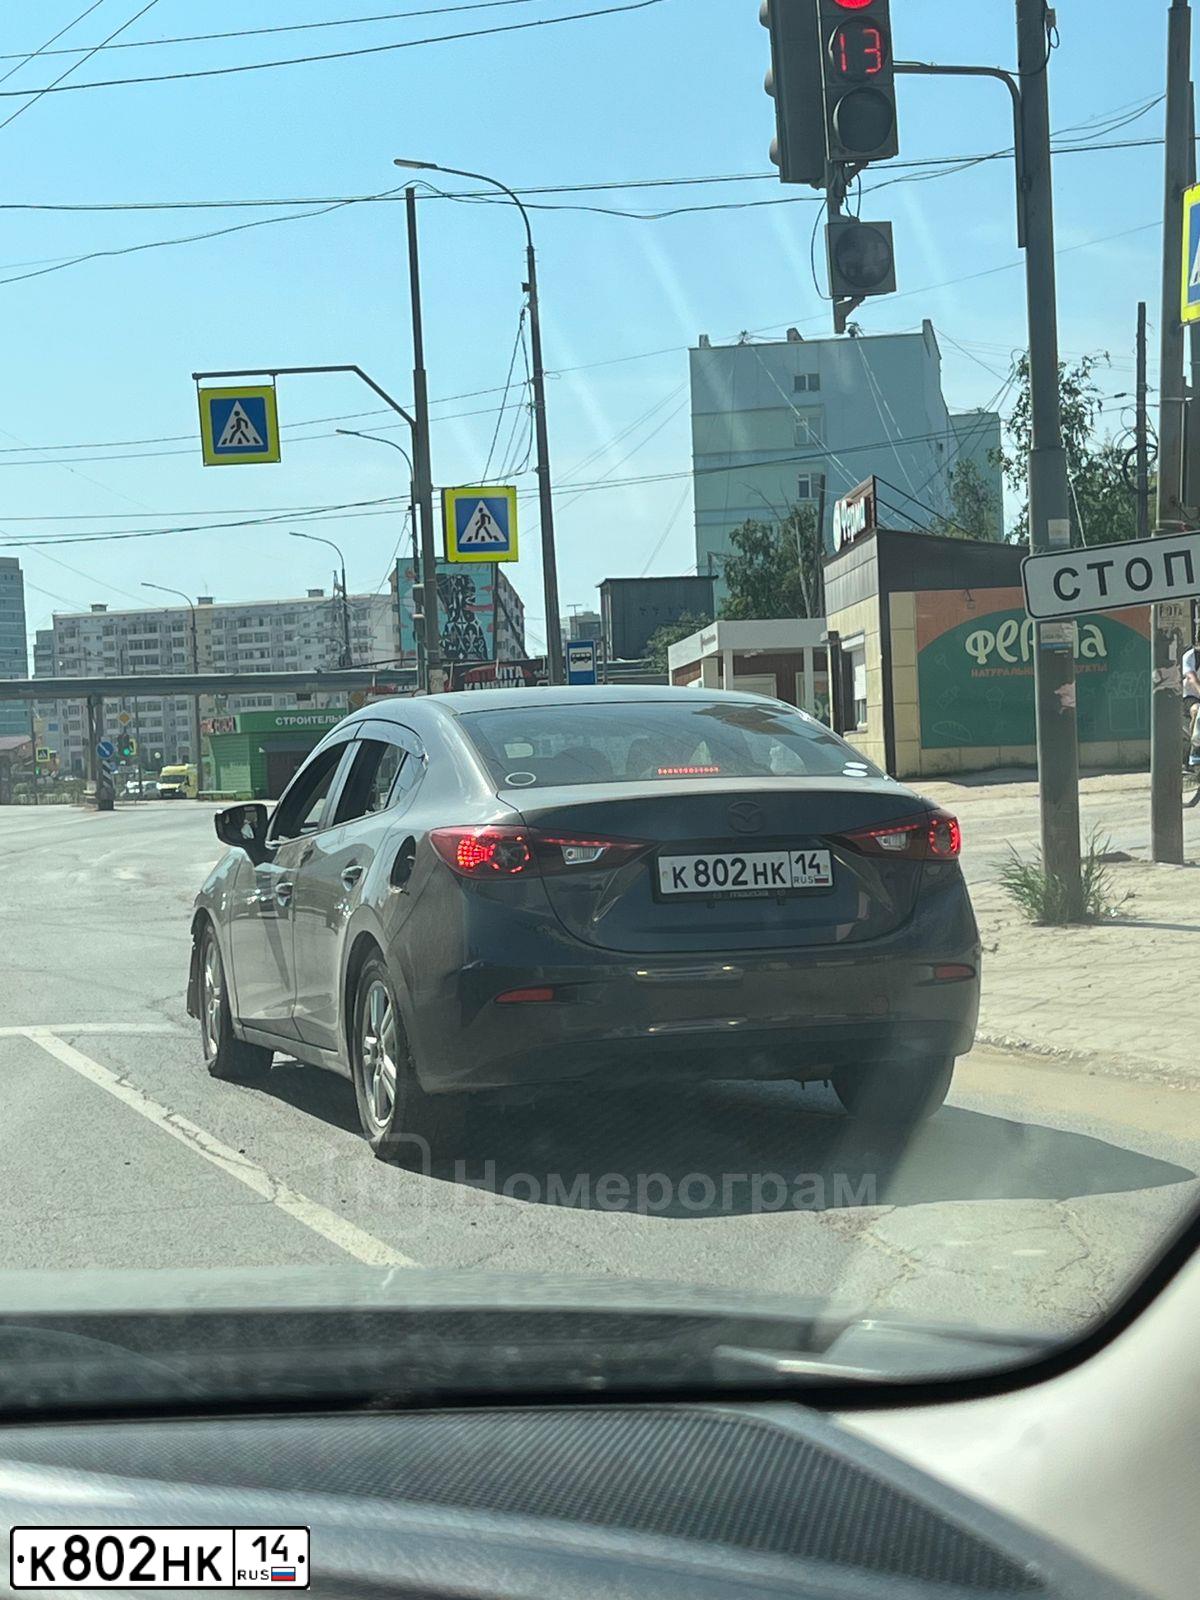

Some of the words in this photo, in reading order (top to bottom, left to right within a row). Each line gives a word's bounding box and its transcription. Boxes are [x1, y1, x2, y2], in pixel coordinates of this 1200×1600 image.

[839, 28, 882, 73] 13
[1053, 550, 1195, 602] СТОП
[965, 618, 1108, 665] Фера
[793, 876, 814, 885] RUS
[794, 853, 821, 875] 14
